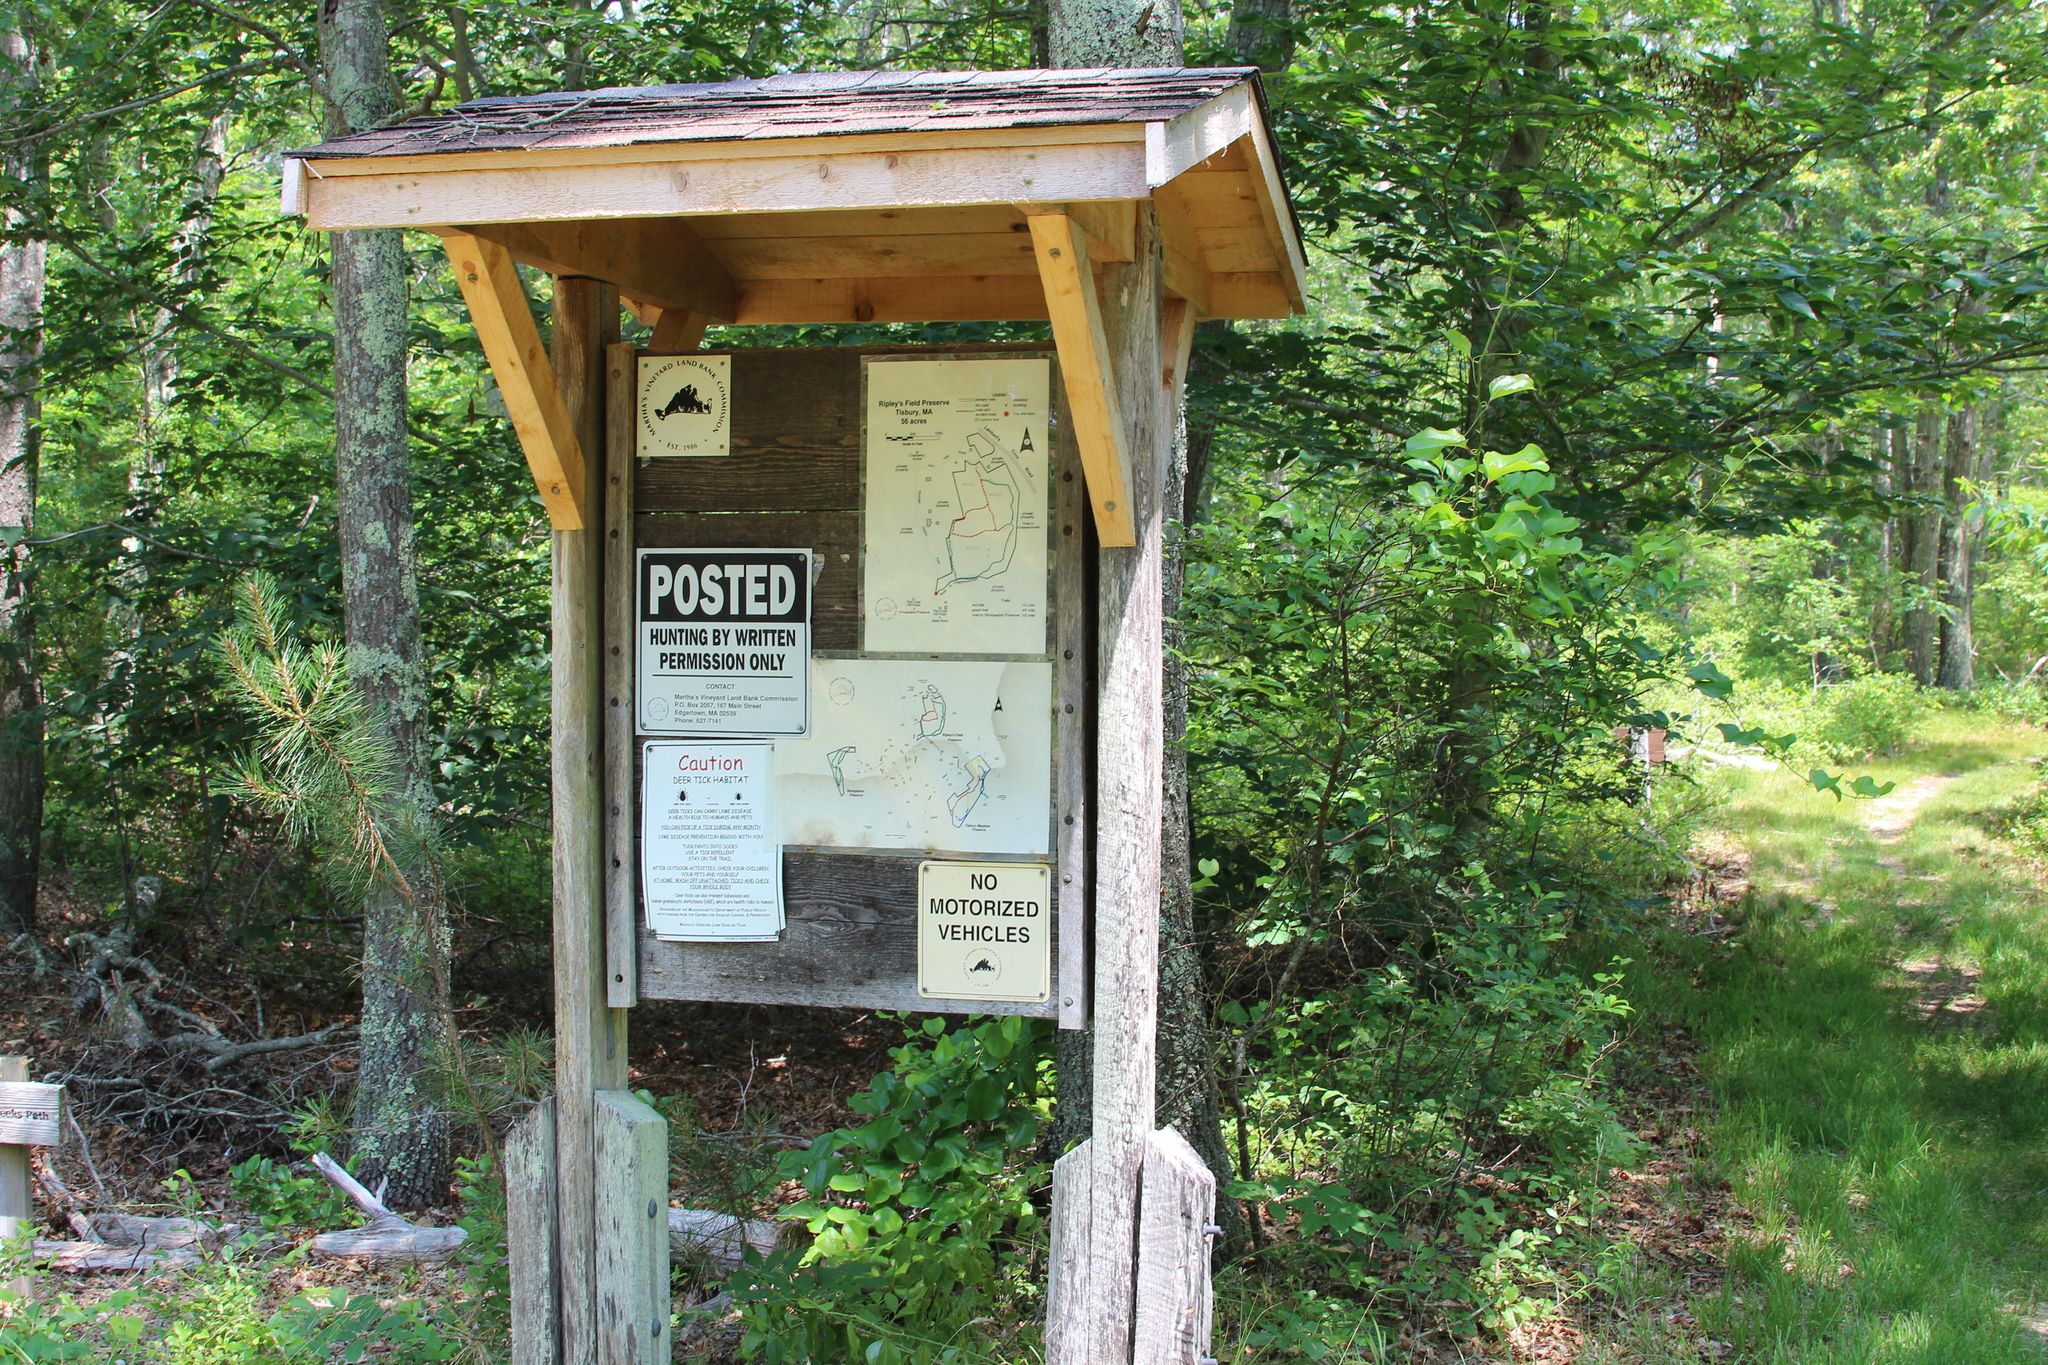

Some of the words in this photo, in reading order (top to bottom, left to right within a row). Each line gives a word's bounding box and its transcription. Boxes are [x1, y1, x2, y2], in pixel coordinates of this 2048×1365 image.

[645, 363, 673, 392] VINEYARD
[699, 363, 716, 379] BANK
[712, 381, 726, 432] COMMISSION
[879, 400, 903, 408] Ripley's
[641, 397, 656, 436] MARTHA'S
[666, 442, 681, 451] EST.
[650, 564, 796, 615] POSTED
[650, 628, 708, 645] HUNTING
[713, 629, 730, 646] BY
[735, 629, 796, 646] WRITTEN
[660, 653, 744, 670] PERMISSION
[750, 654, 785, 670] ONLY
[679, 754, 743, 771] Caution
[673, 776, 691, 784] DEER
[971, 874, 997, 890] NO
[930, 899, 1039, 917] MOTORIZED
[938, 924, 1030, 943] VEHICLES
